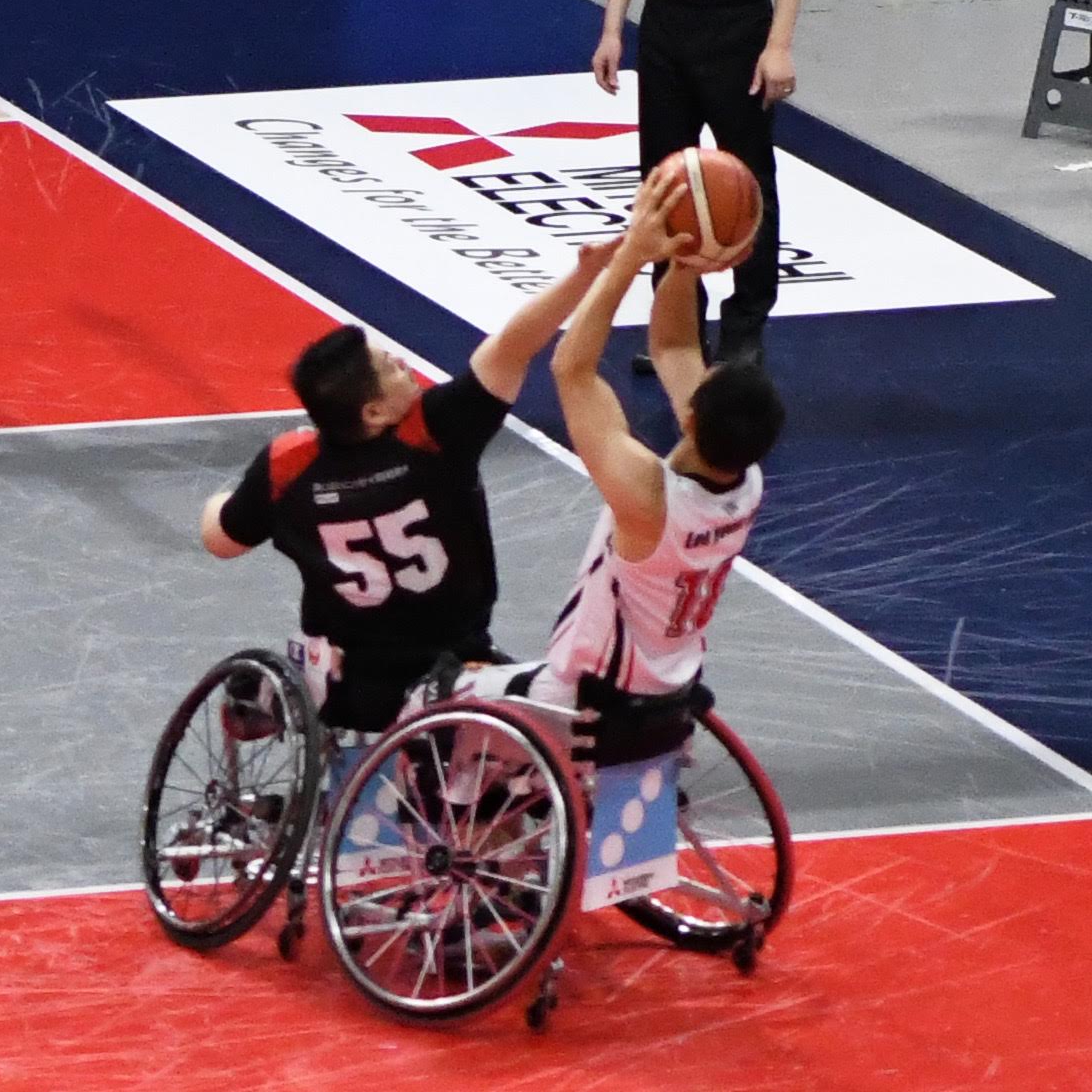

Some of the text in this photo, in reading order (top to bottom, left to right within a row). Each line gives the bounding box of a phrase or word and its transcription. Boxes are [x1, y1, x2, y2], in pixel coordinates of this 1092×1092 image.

[235, 118, 555, 295] Changes for the Bette
[317, 498, 449, 608] 55
